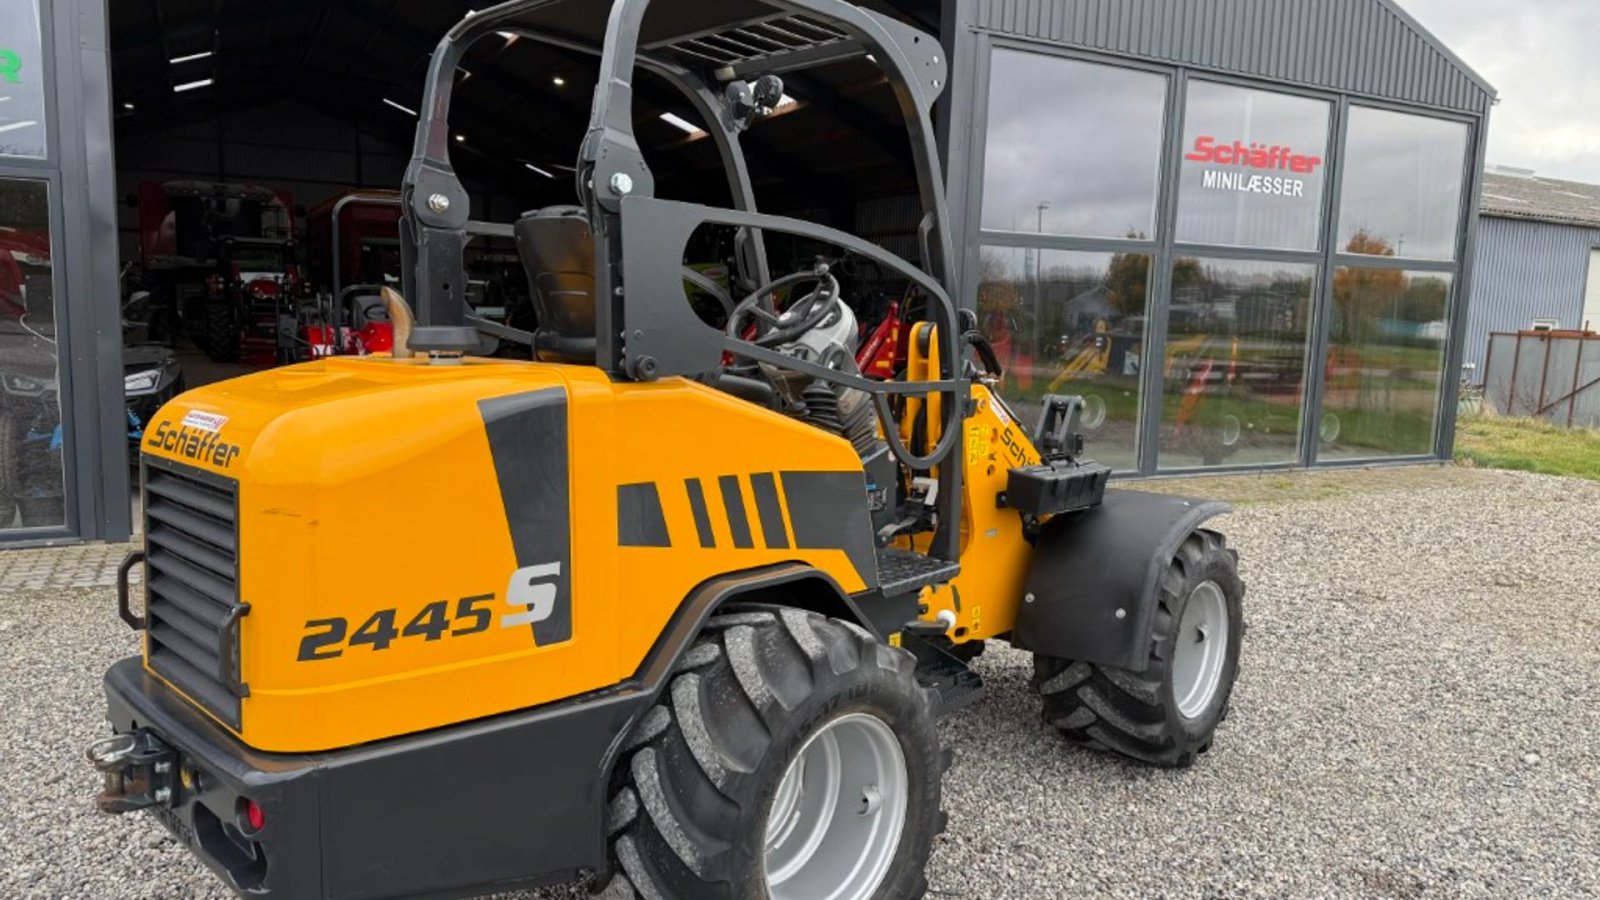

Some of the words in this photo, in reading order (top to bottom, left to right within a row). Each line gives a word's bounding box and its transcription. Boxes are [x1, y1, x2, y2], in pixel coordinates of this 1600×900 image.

[1184, 136, 1321, 173] Schäffer
[1202, 170, 1304, 198] MINILÆSSER
[147, 420, 241, 468] Schäffer
[296, 593, 496, 662] 2445
